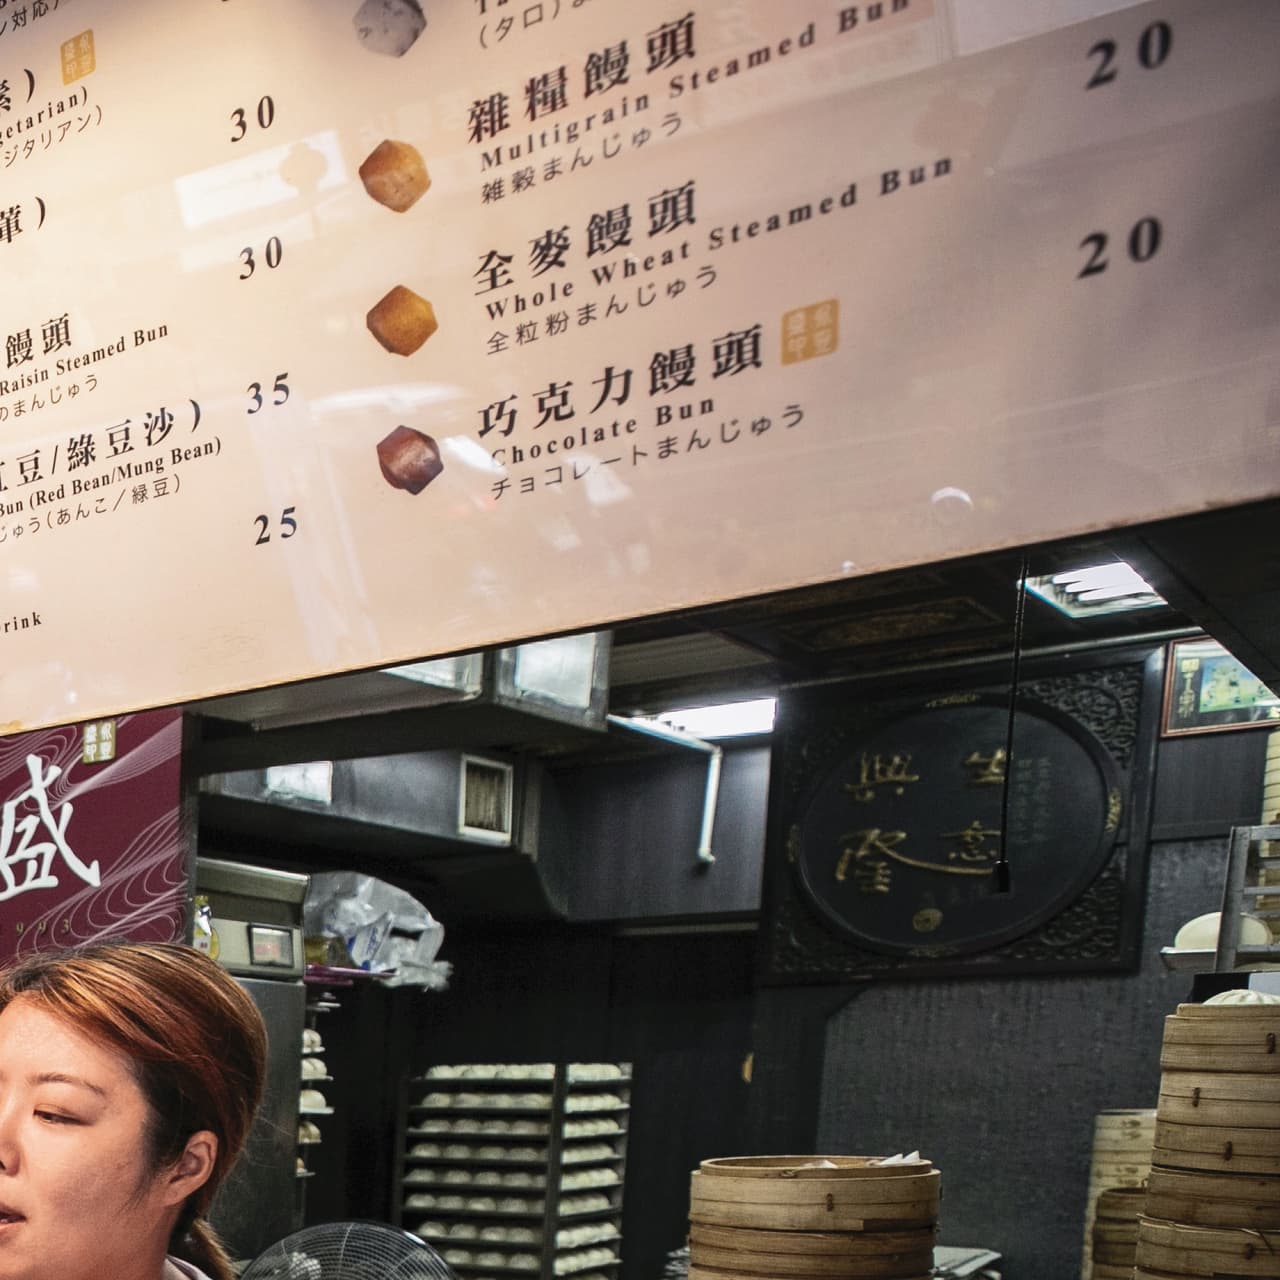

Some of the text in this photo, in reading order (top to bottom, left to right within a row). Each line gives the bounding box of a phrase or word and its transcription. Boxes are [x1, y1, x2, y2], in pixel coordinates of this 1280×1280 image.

[467, 12, 697, 145] 雜糧饅頭
[480, 0, 910, 173] Multigrain Steamed Bun
[1085, 19, 1174, 91] 20
[228, 94, 276, 145] 30
[481, 110, 684, 207] 雑穀まんじゅう
[238, 235, 284, 281] 30
[473, 180, 698, 297] 全麥饅頭
[485, 154, 955, 322] Whole Wheat Steamed Bun
[1076, 215, 1164, 281] 20
[486, 264, 719, 357] 全粒粉まんじゅう
[54, 337, 127, 378] Steamed
[132, 322, 170, 350] Bun
[476, 323, 765, 441] 巧克力饅頭
[245, 371, 291, 416] 35
[490, 393, 718, 470] Chocolate Bun
[28, 480, 69, 512] (Red
[71, 454, 166, 500] Bean/Mung
[170, 435, 223, 468] Bean)
[490, 403, 807, 501] チョコレートまんじゅう
[254, 506, 299, 547] 25
